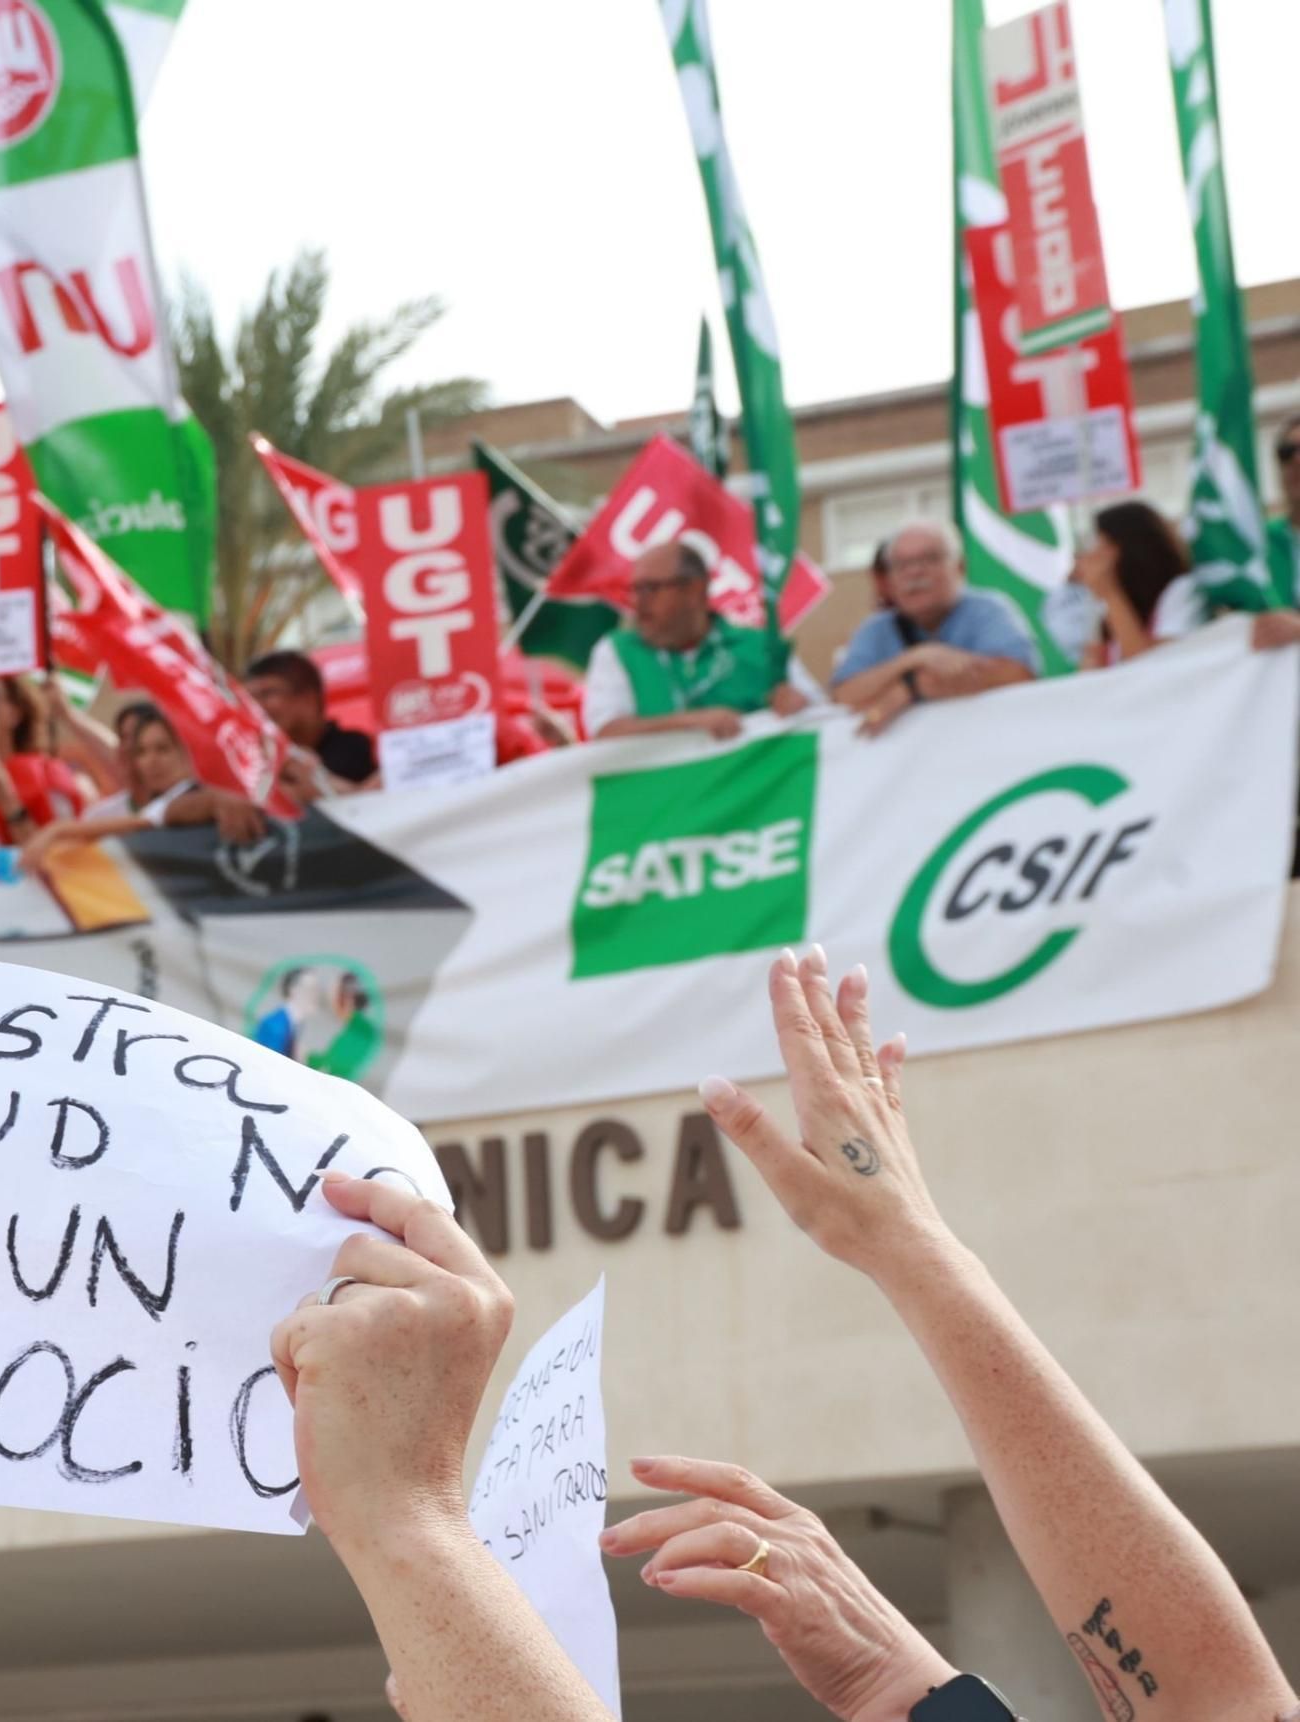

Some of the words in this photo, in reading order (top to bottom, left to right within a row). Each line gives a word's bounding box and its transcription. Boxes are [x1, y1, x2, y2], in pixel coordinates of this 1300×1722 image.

[378, 485, 474, 679] UGT
[582, 816, 803, 910] SATSE
[943, 816, 1156, 924] CSIF
[6, 1203, 186, 1322] UN
